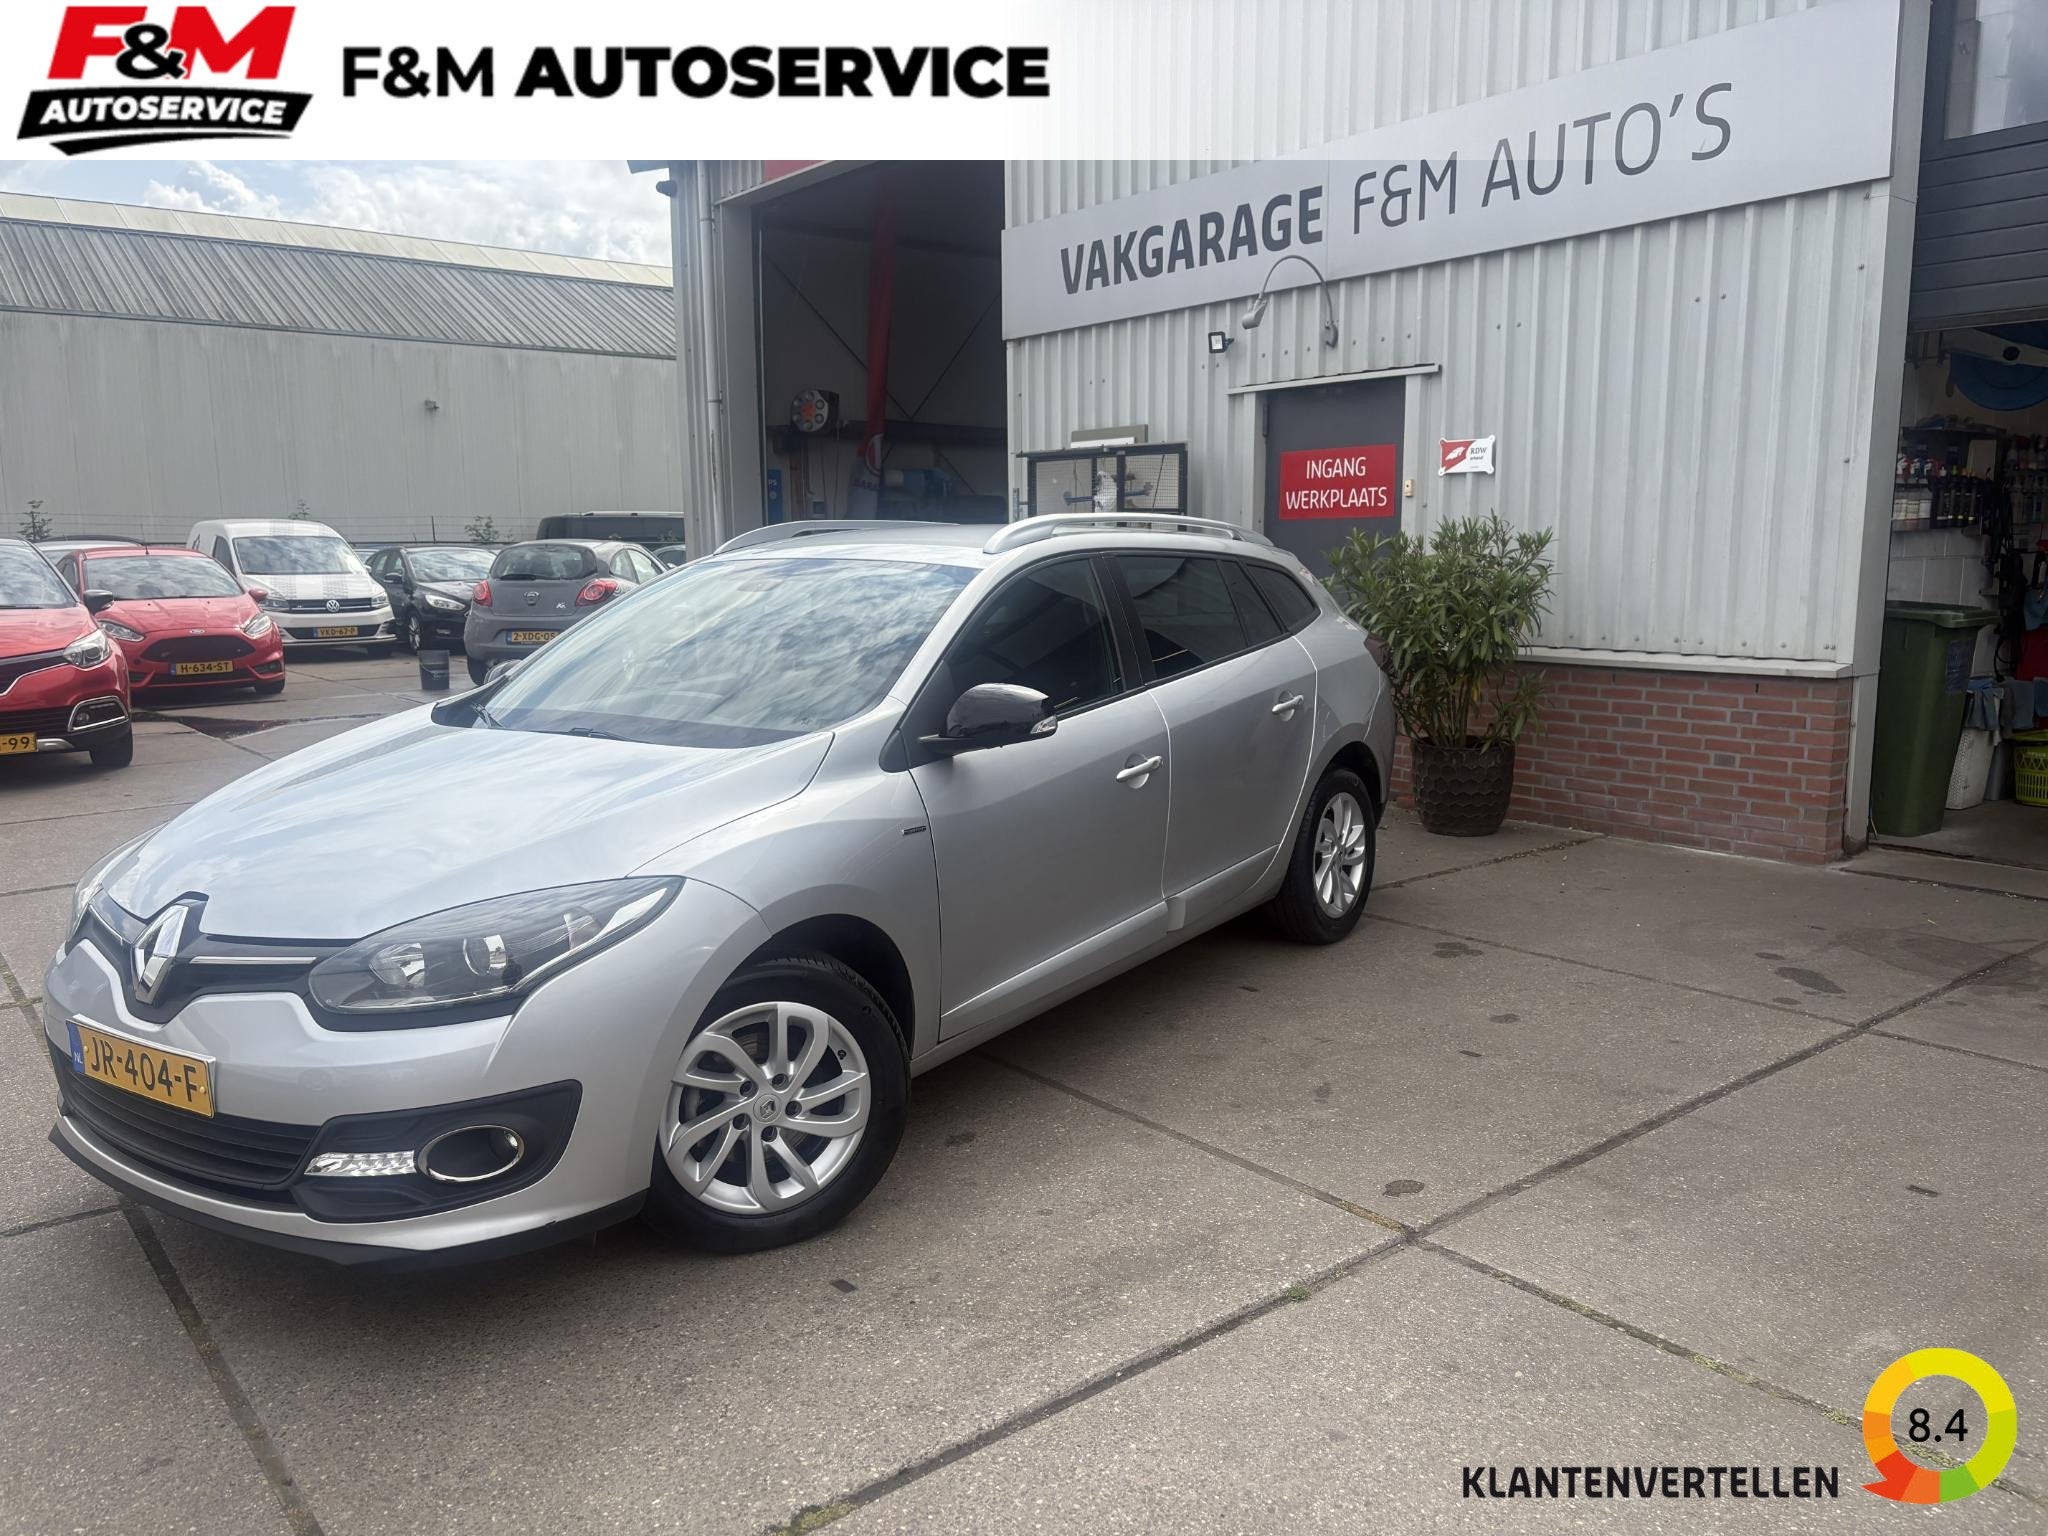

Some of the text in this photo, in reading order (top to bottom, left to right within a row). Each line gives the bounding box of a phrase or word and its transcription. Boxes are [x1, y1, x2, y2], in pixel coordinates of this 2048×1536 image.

[1060, 82, 1732, 294] VAKGARAGE F&M AUTO'S
[1306, 456, 1367, 479] INGANG
[1285, 487, 1388, 510] WERKPLAATS
[180, 662, 230, 673] H-634-ST
[91, 1036, 198, 1103] JR-404-F
